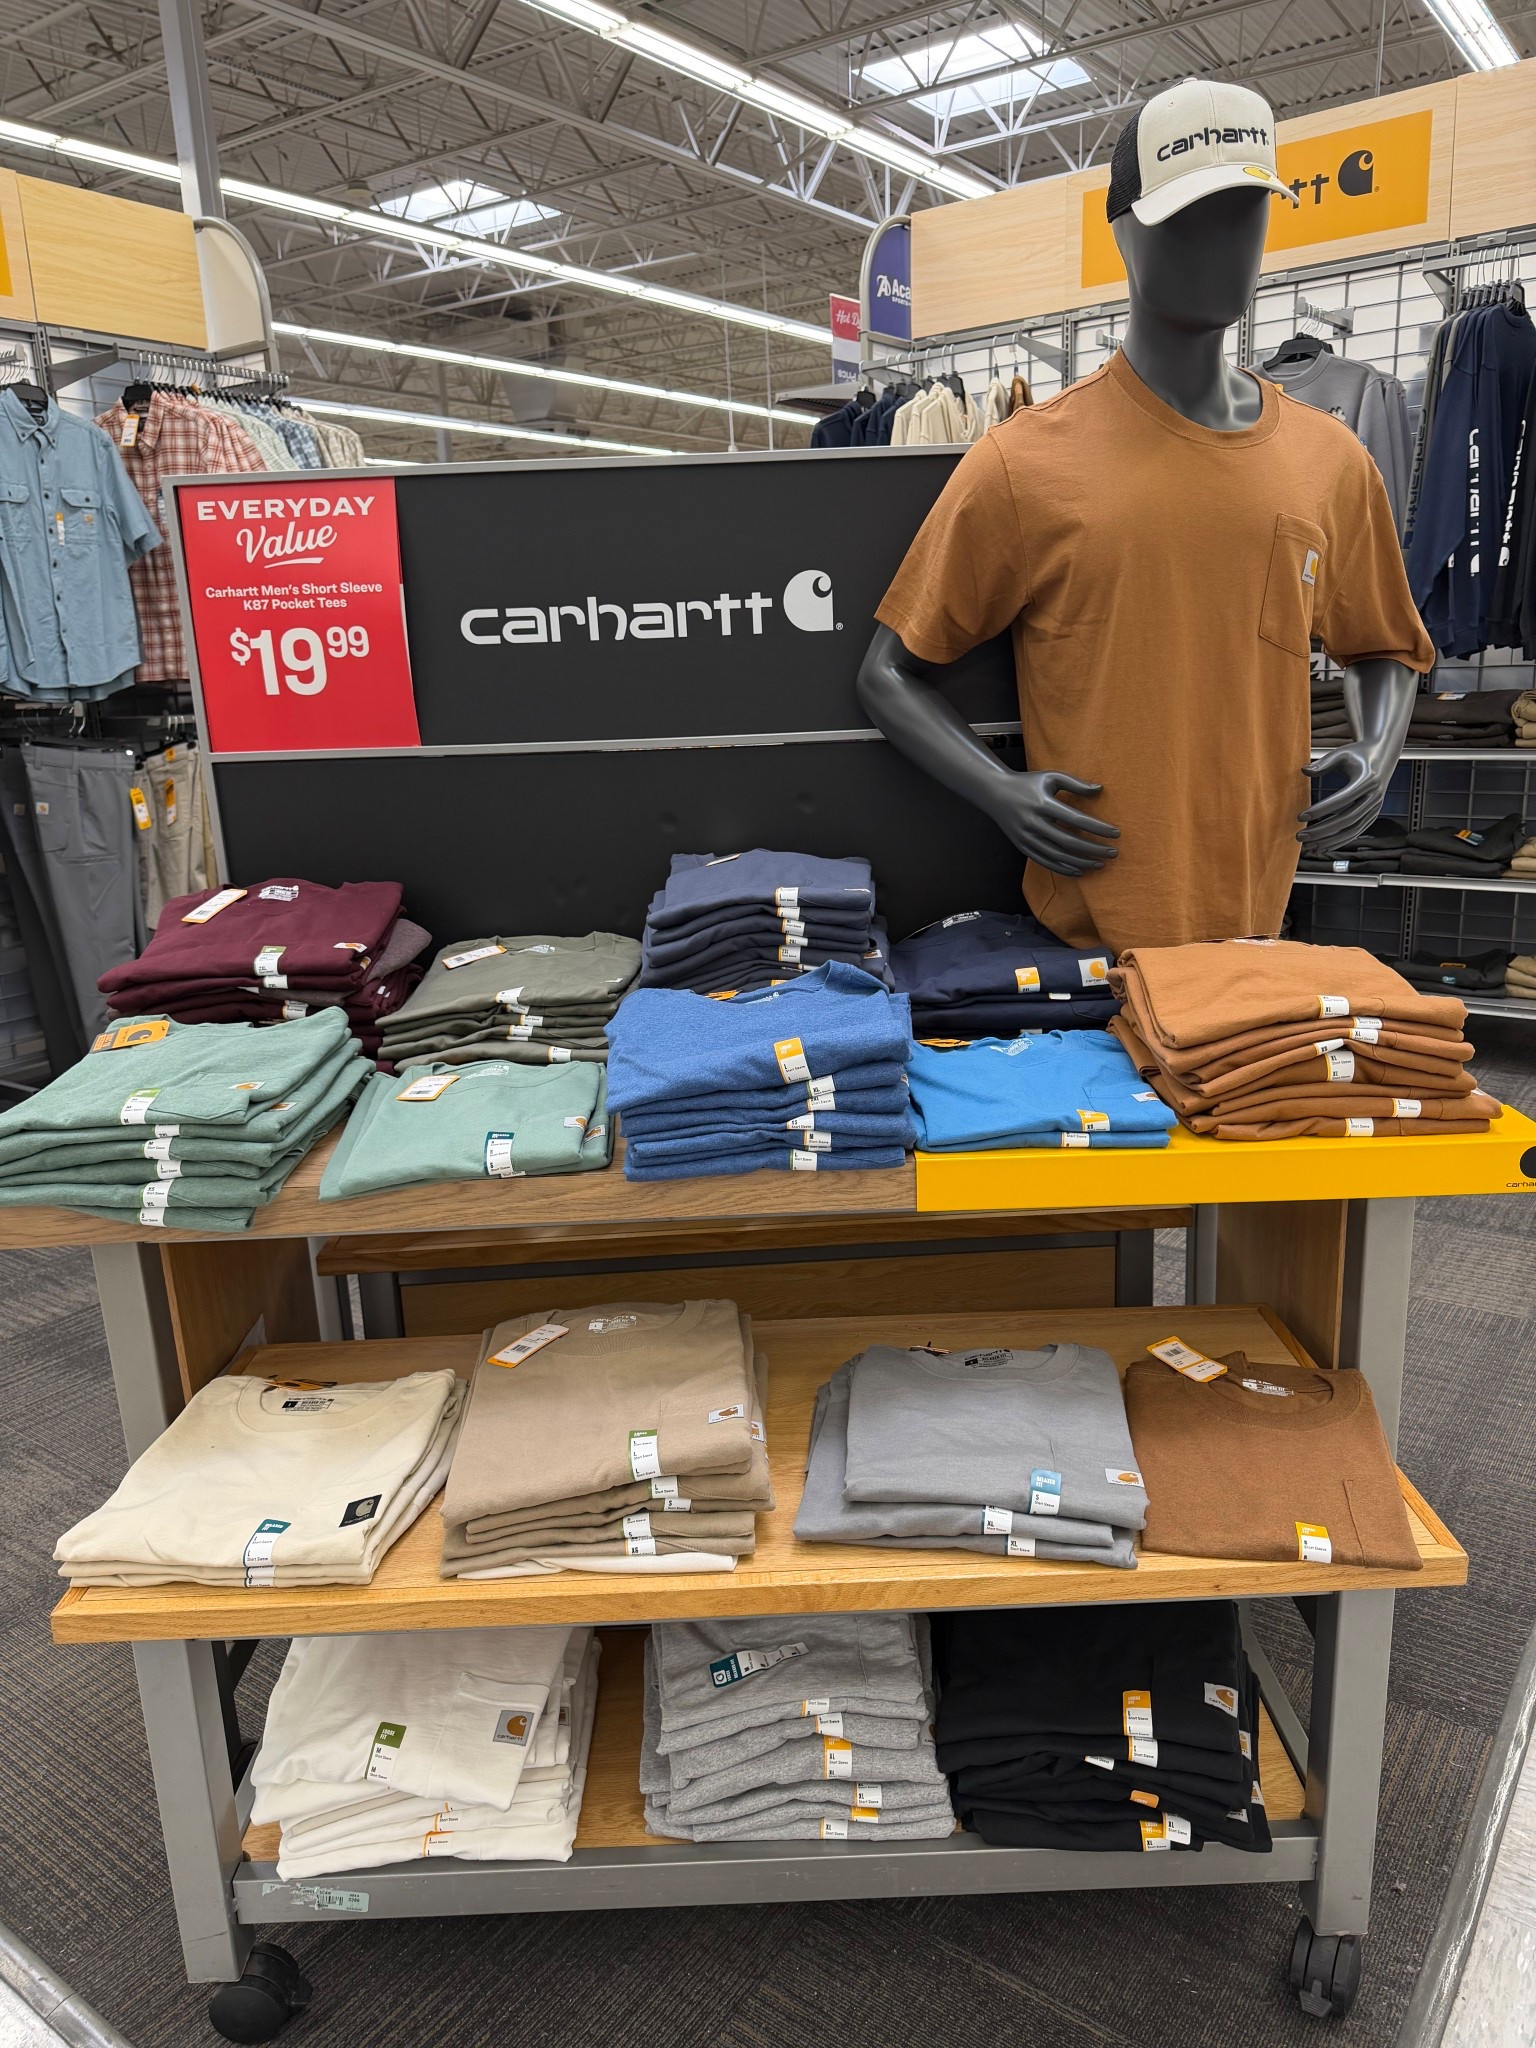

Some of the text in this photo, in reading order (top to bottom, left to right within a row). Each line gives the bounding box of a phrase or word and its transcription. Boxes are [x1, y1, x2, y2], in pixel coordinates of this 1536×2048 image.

[1156, 126, 1267, 162] carhartt
[197, 496, 376, 521] EVERYDAY
[236, 521, 338, 563] Value
[206, 582, 382, 598] Carhartt Men's Short Sleeve
[243, 597, 348, 611] K87 Pocket Tees
[460, 592, 772, 644] carhartt
[1208, 1698, 1234, 1712] carhartt
